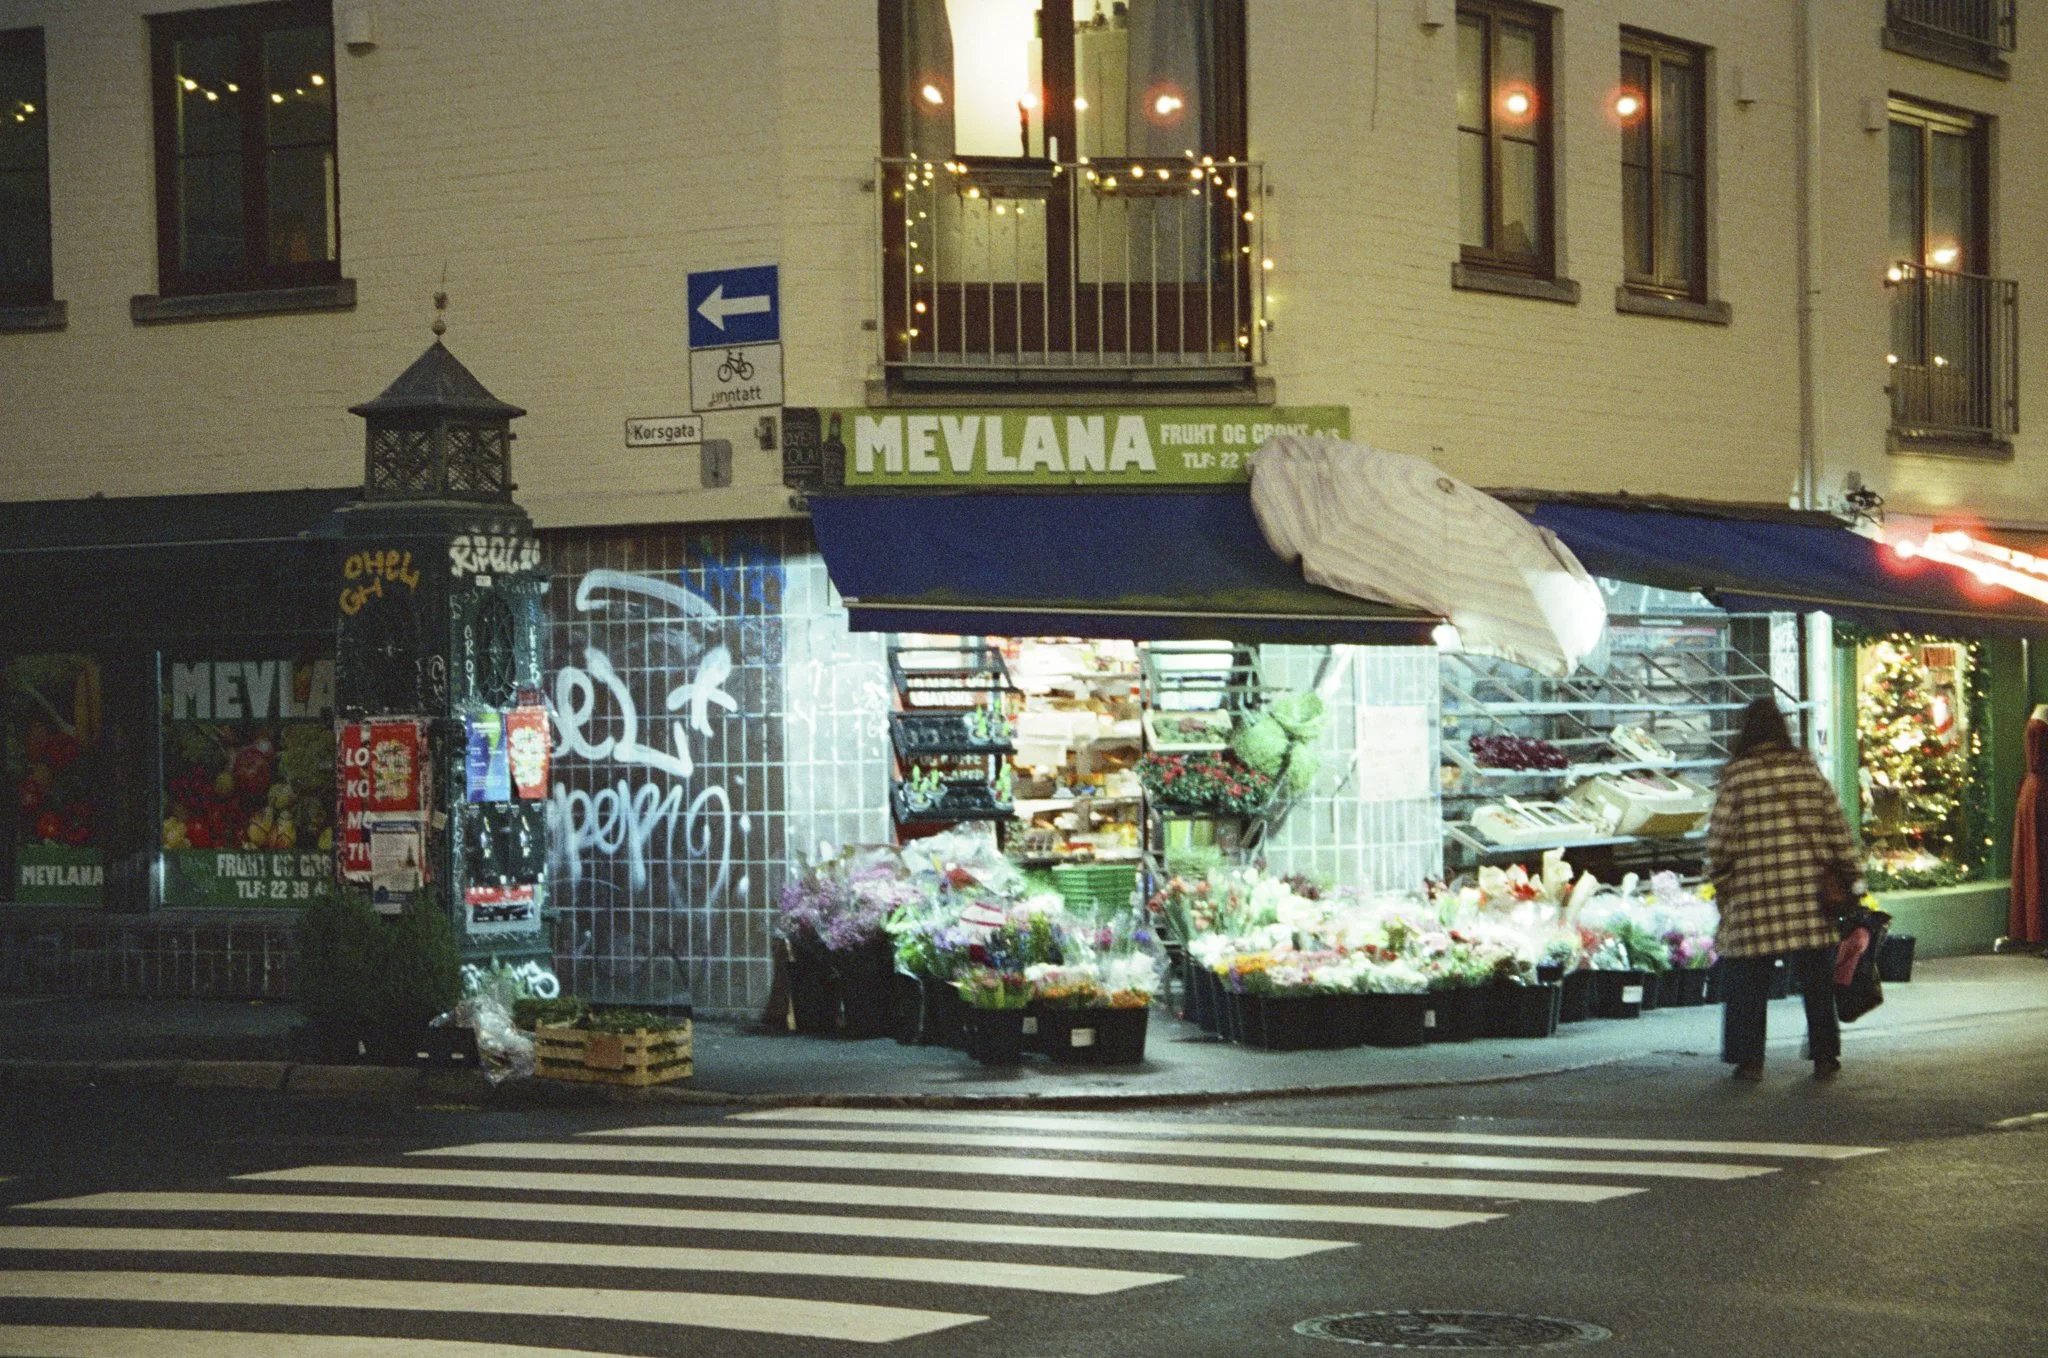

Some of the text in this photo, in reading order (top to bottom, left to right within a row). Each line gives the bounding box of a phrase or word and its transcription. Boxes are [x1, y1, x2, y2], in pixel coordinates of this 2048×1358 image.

[710, 386, 762, 403] unntatt
[633, 424, 695, 442] Korsgata
[1160, 423, 1218, 445] FRUKT
[1222, 423, 1247, 444] OG
[854, 414, 1157, 473] MEVLANA
[1182, 451, 1216, 469] TLF:
[1220, 452, 1240, 469] 22
[345, 748, 370, 767] LO
[347, 780, 370, 798] KO
[21, 864, 104, 886] MEVLANA
[270, 880, 288, 898] 22
